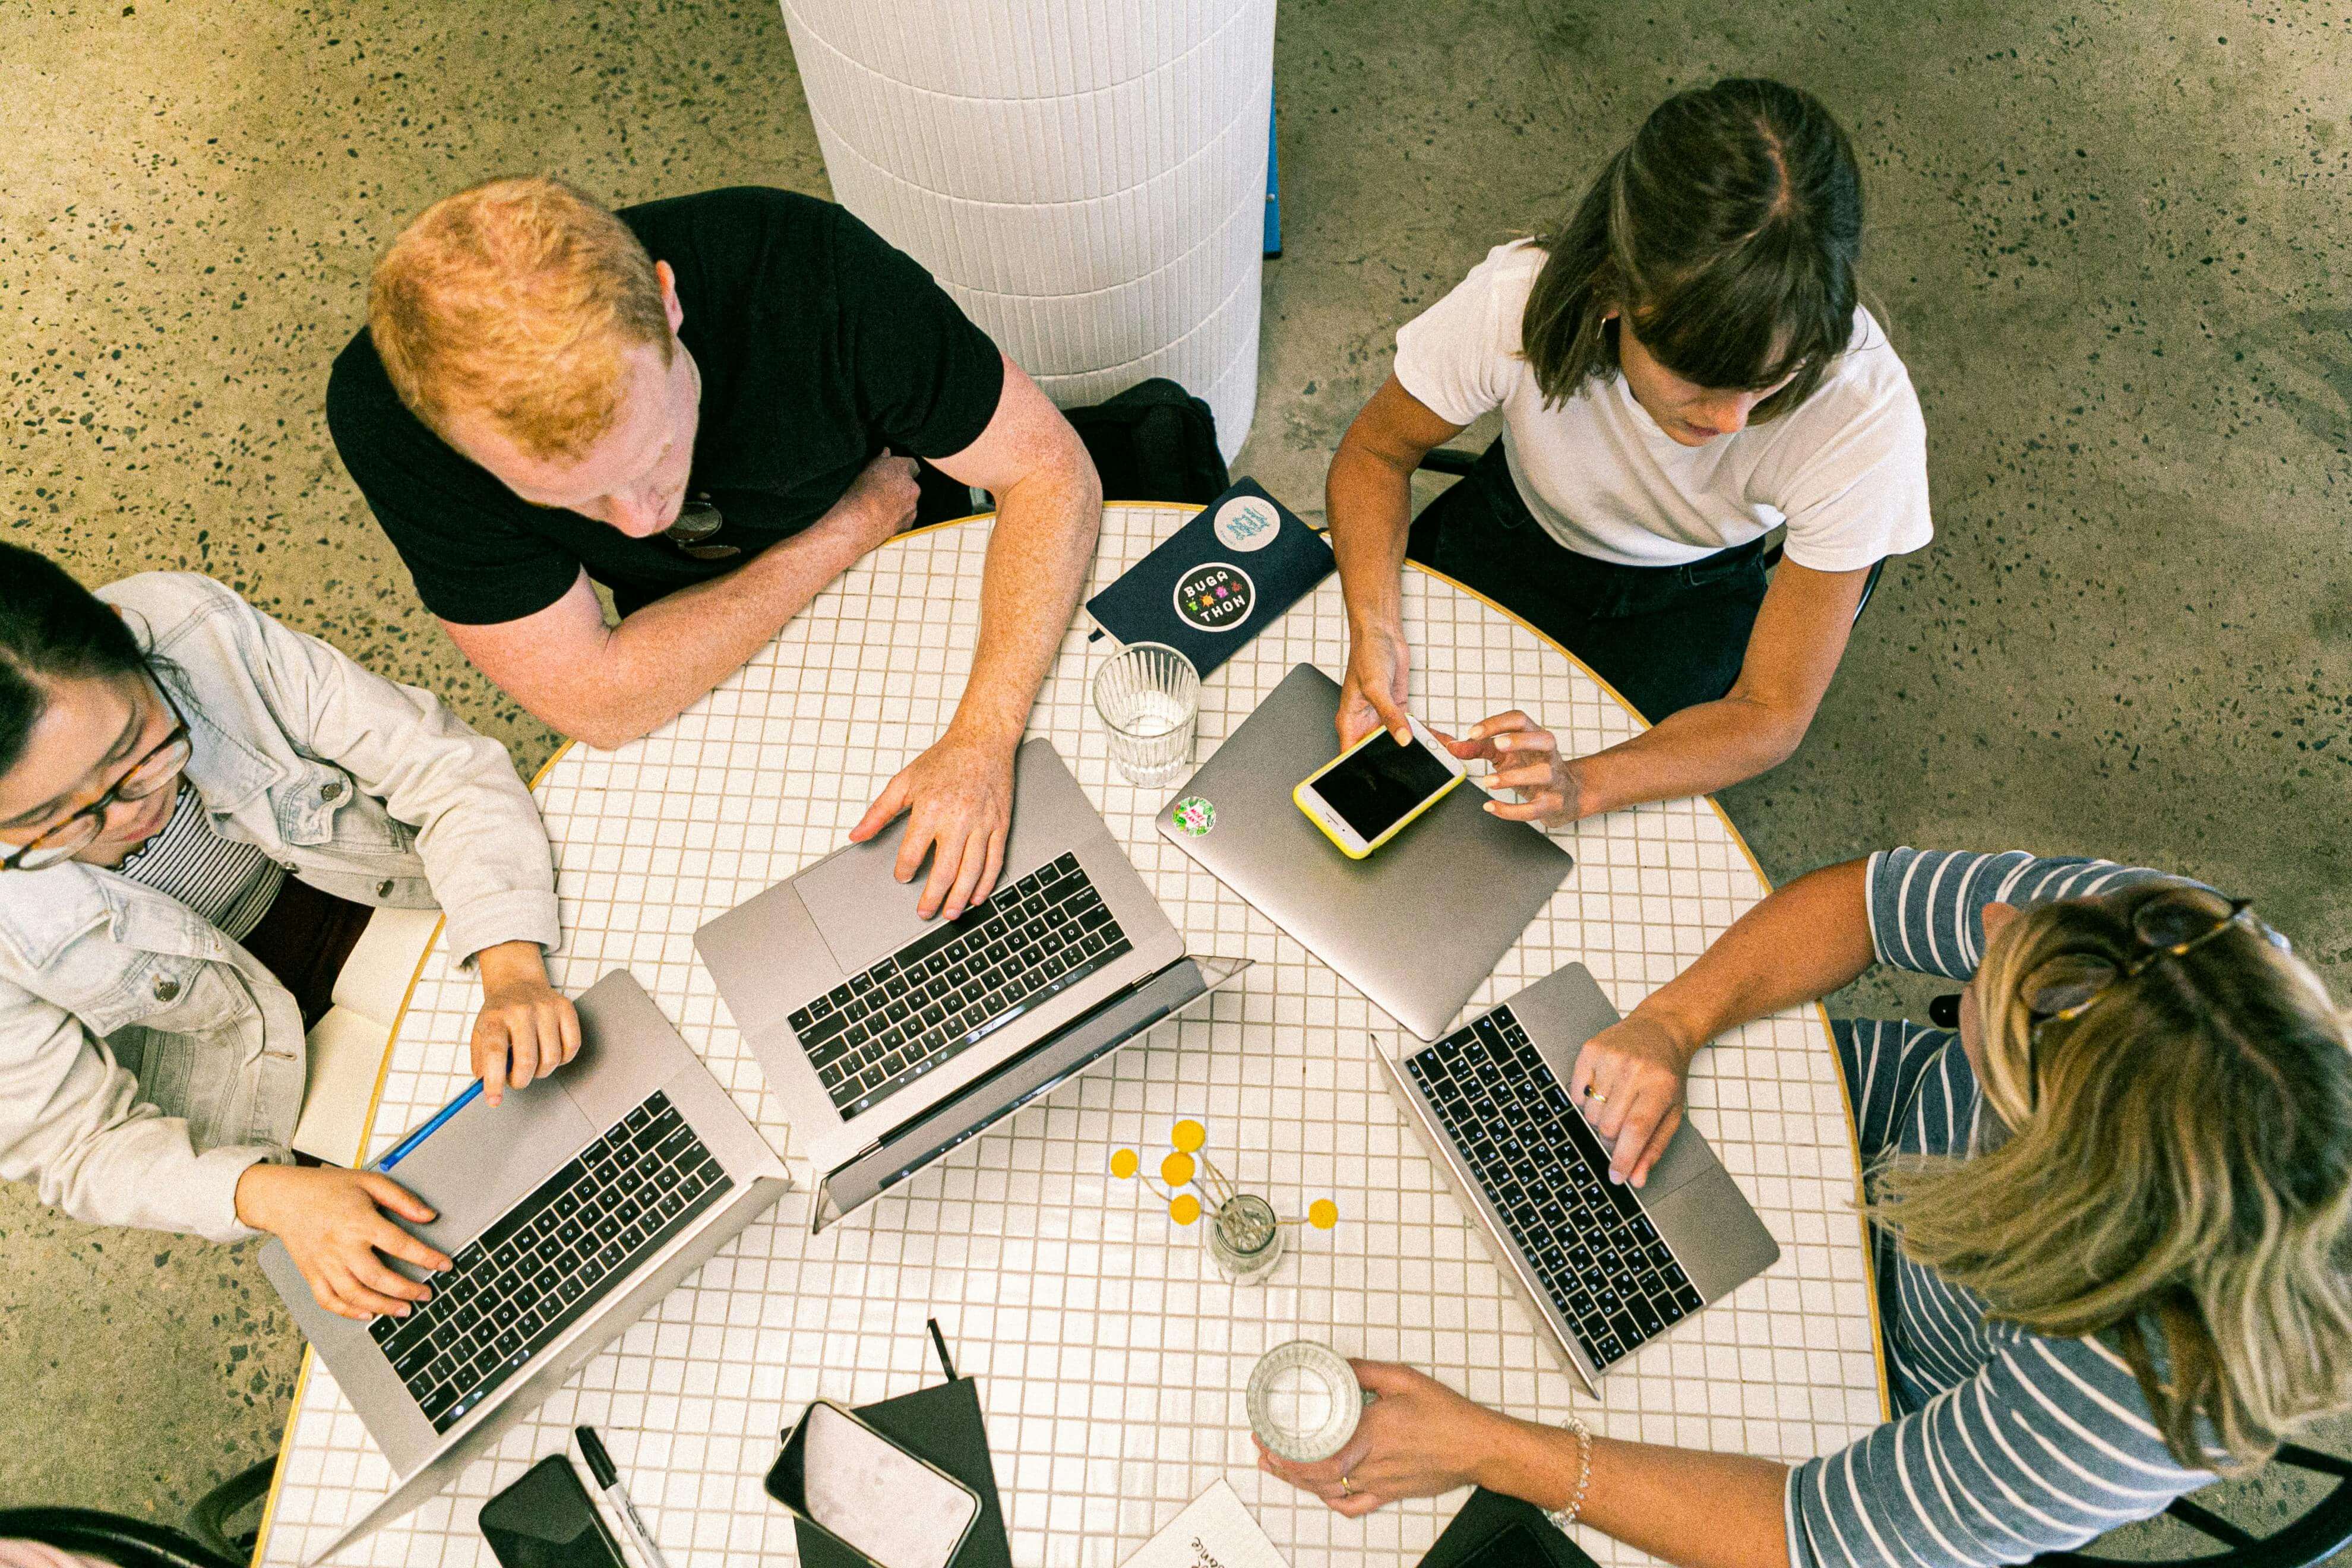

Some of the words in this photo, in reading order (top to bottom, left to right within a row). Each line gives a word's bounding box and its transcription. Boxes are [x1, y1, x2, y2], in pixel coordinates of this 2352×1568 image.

[1184, 571, 1228, 598] BUGA
[1200, 595, 1245, 622] THON
[992, 925, 1000, 933] C
[1048, 940, 1057, 949] W
[973, 960, 981, 968] G
[913, 971, 921, 979] M
[909, 1023, 917, 1031] O
[890, 1035, 897, 1043] P
[1548, 1136, 1557, 1145] M
[622, 1153, 630, 1162] Z
[1563, 1157, 1570, 1165] N
[663, 1175, 671, 1184] Q
[583, 1186, 590, 1194] C
[606, 1194, 614, 1203] D
[643, 1191, 653, 1201] W
[563, 1203, 571, 1211] V
[1564, 1200, 1572, 1209] G
[624, 1208, 632, 1216] E
[542, 1219, 551, 1227] B
[565, 1228, 574, 1237] G
[605, 1225, 612, 1233] R
[522, 1235, 530, 1244] N
[545, 1245, 554, 1254] H
[585, 1243, 592, 1251] T
[1592, 1244, 1600, 1252] D
[501, 1252, 510, 1262] M
[525, 1262, 531, 1270] J
[504, 1279, 512, 1288] K
[543, 1276, 551, 1285] U
[1589, 1283, 1598, 1292] W
[1604, 1305, 1613, 1314] Q
[501, 1310, 510, 1319] O
[482, 1328, 489, 1337] P
